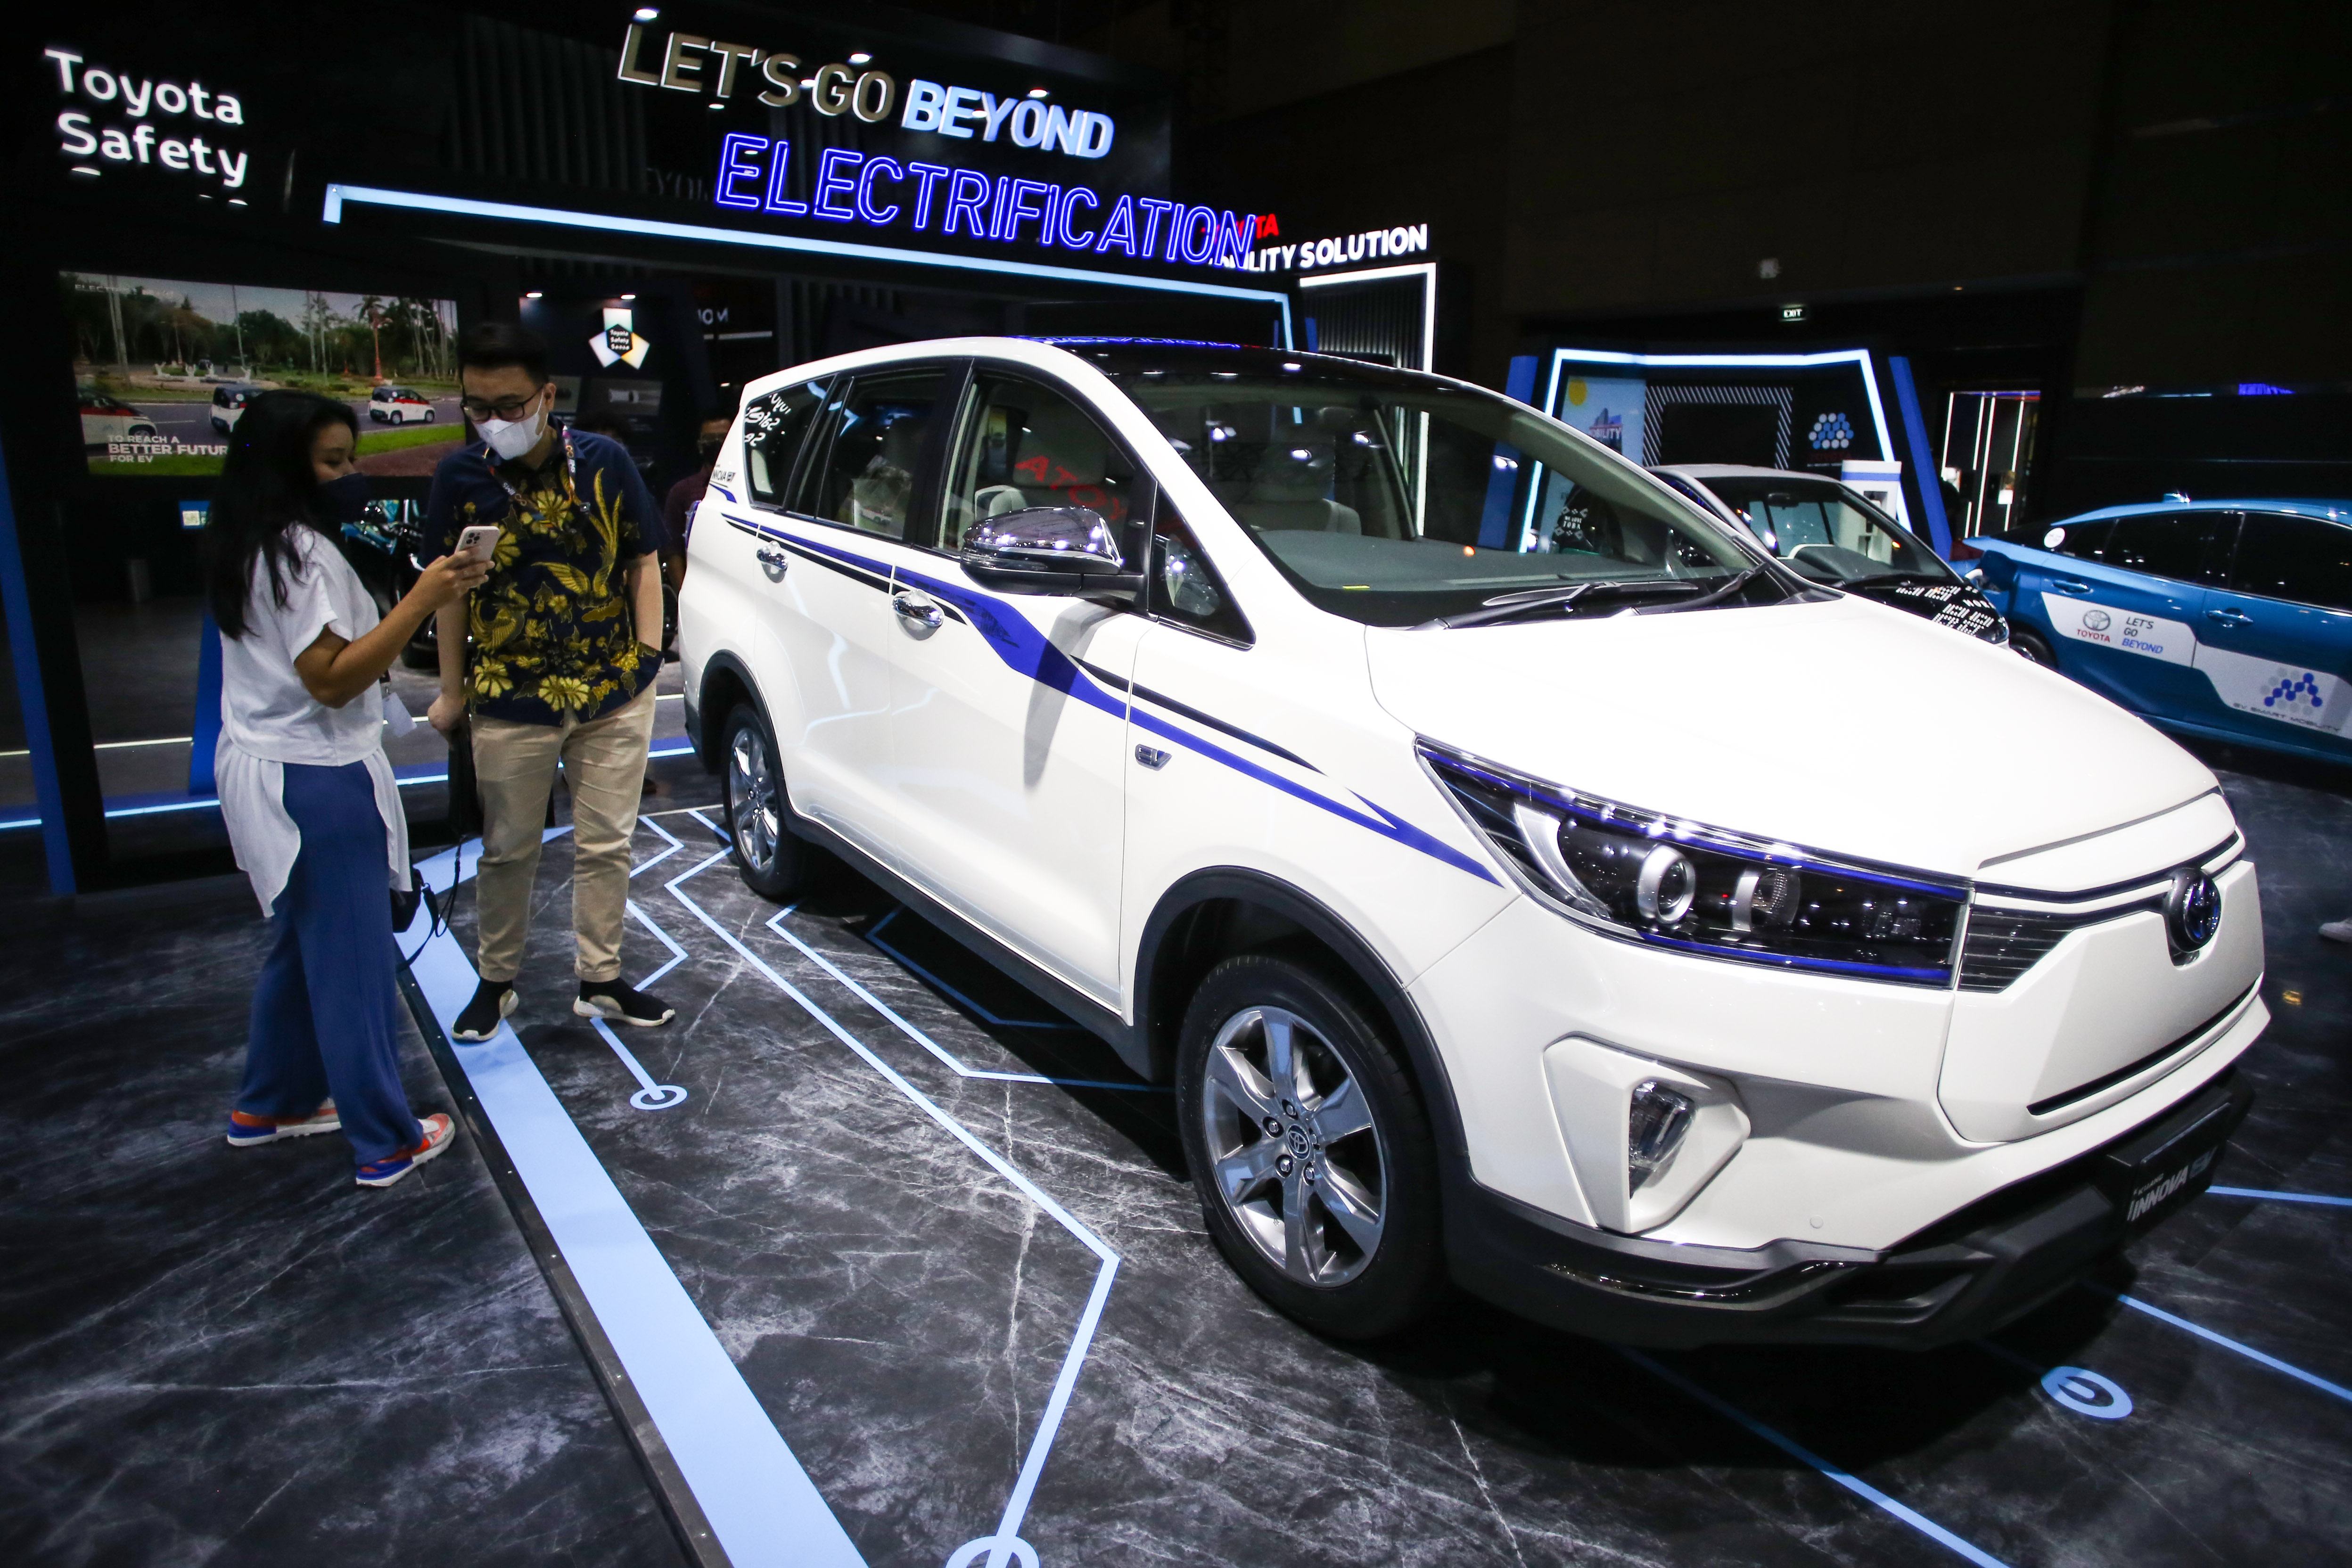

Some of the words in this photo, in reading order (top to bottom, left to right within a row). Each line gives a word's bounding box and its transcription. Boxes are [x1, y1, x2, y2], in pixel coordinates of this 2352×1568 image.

[44, 48, 244, 125] Toyota
[617, 24, 802, 108] LET'S
[812, 63, 895, 123] GO
[901, 78, 1116, 159] BEYOND
[57, 112, 248, 188] Safety
[714, 131, 1257, 272] ELECTRIFICATION
[1299, 224, 1428, 269] SOLUTION
[1784, 308, 1803, 318] EXIT
[127, 435, 167, 443] REACH
[108, 443, 173, 454] BETTER
[177, 444, 228, 455] FUTUR
[110, 455, 134, 463] FOR
[1563, 520, 1581, 530] TOBA
[2076, 629, 2111, 643] TOYOTA
[2124, 627, 2138, 637] GO
[2122, 638, 2164, 654] BEYOND
[2127, 1165, 2189, 1222] INNOVA
